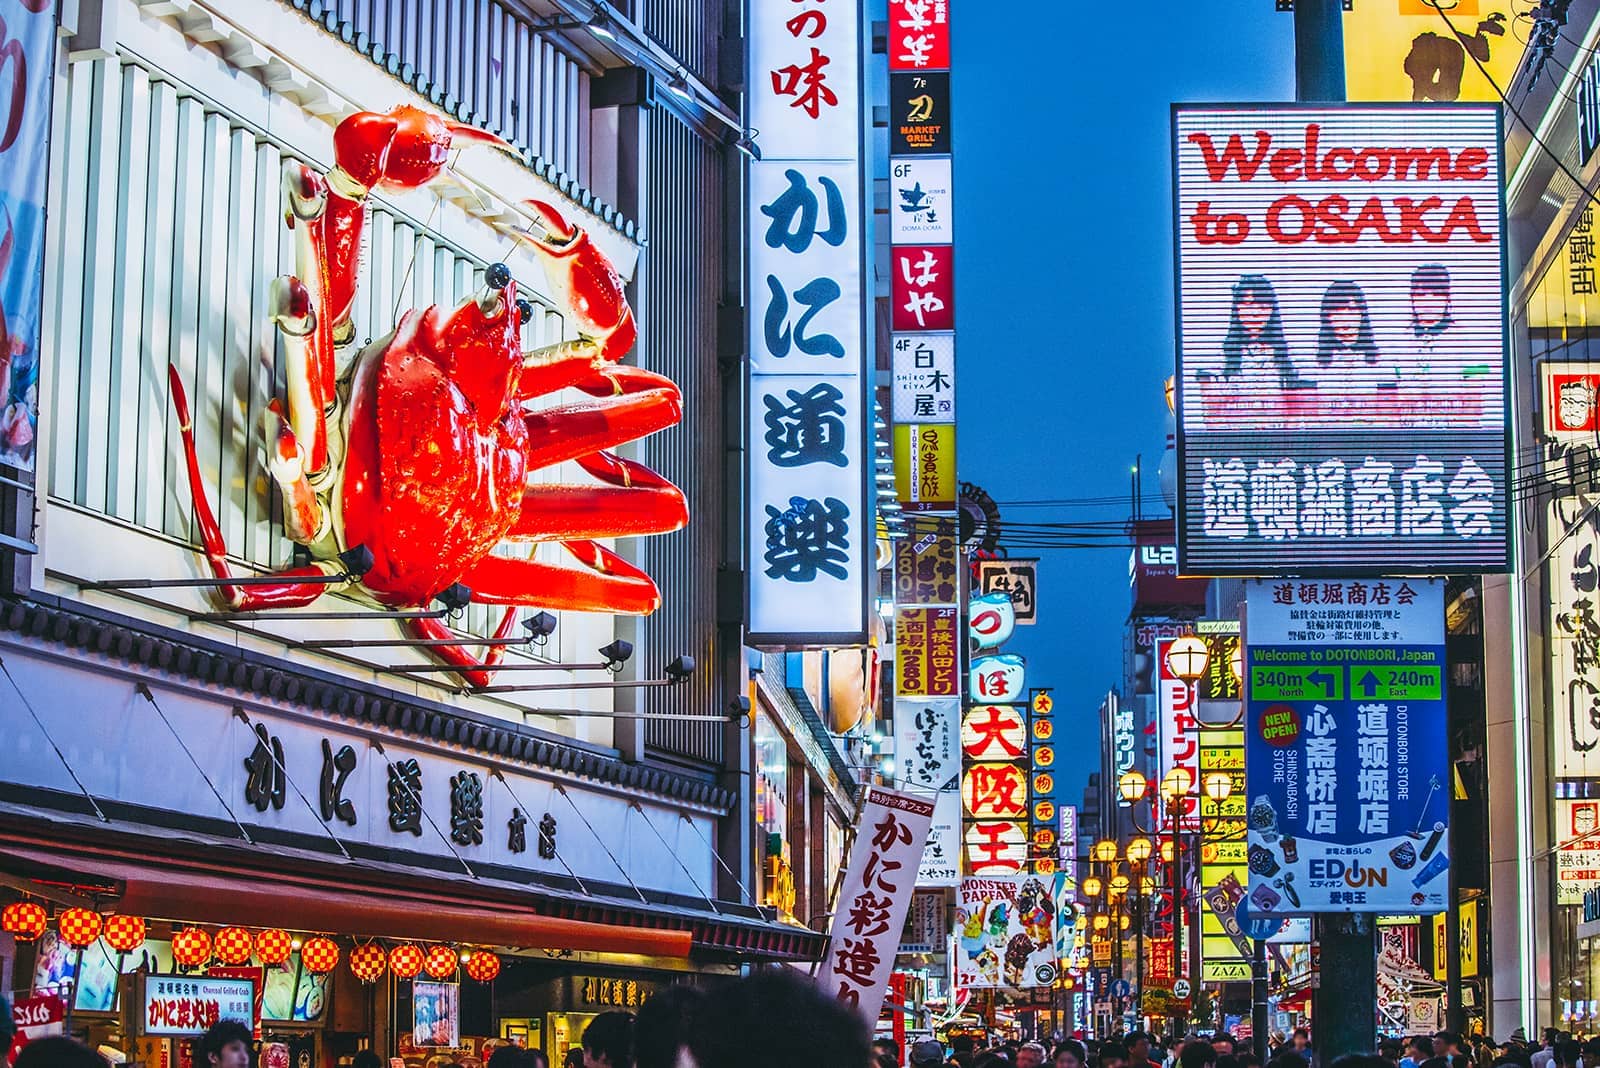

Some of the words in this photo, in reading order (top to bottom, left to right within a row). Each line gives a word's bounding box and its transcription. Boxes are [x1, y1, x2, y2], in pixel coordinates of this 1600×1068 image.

[770, 0, 838, 119] の味
[913, 77, 927, 89] 7F
[900, 126, 941, 134] MARKET
[906, 134, 936, 143] GRILL
[1188, 124, 1489, 182] Welcome
[894, 164, 912, 178] 6F
[1189, 200, 1250, 245] to
[1265, 194, 1493, 245] OSAKA
[900, 250, 944, 326] はや
[895, 339, 911, 351] 4F
[913, 342, 951, 416] 白木屋
[1272, 582, 1418, 606] 道頓堀商店会
[938, 609, 956, 618] 2F
[1253, 649, 1307, 661] Welcome
[1310, 650, 1322, 661] to
[1325, 650, 1400, 663] DOTONBORI,
[1401, 650, 1436, 663] Japan
[1256, 671, 1302, 686] 340m
[1388, 671, 1435, 686] 240m
[1279, 688, 1304, 697] North
[1389, 689, 1408, 697] East
[1265, 711, 1291, 725] NEW
[1263, 722, 1297, 739] OPEN!
[1396, 705, 1408, 765] DOTONBORI
[1273, 749, 1285, 784] STORE
[1305, 703, 1338, 834] 心斋桥店
[1357, 703, 1389, 834] 道顿堀店
[965, 706, 1026, 871] 大阪王
[1286, 749, 1297, 820] SHINSAIBASHI
[1397, 766, 1409, 800] STORE
[1308, 858, 1387, 888] EDION
[960, 879, 1017, 892] MONSTER
[960, 974, 976, 985] 2F
[1211, 966, 1246, 977] ZAZA
